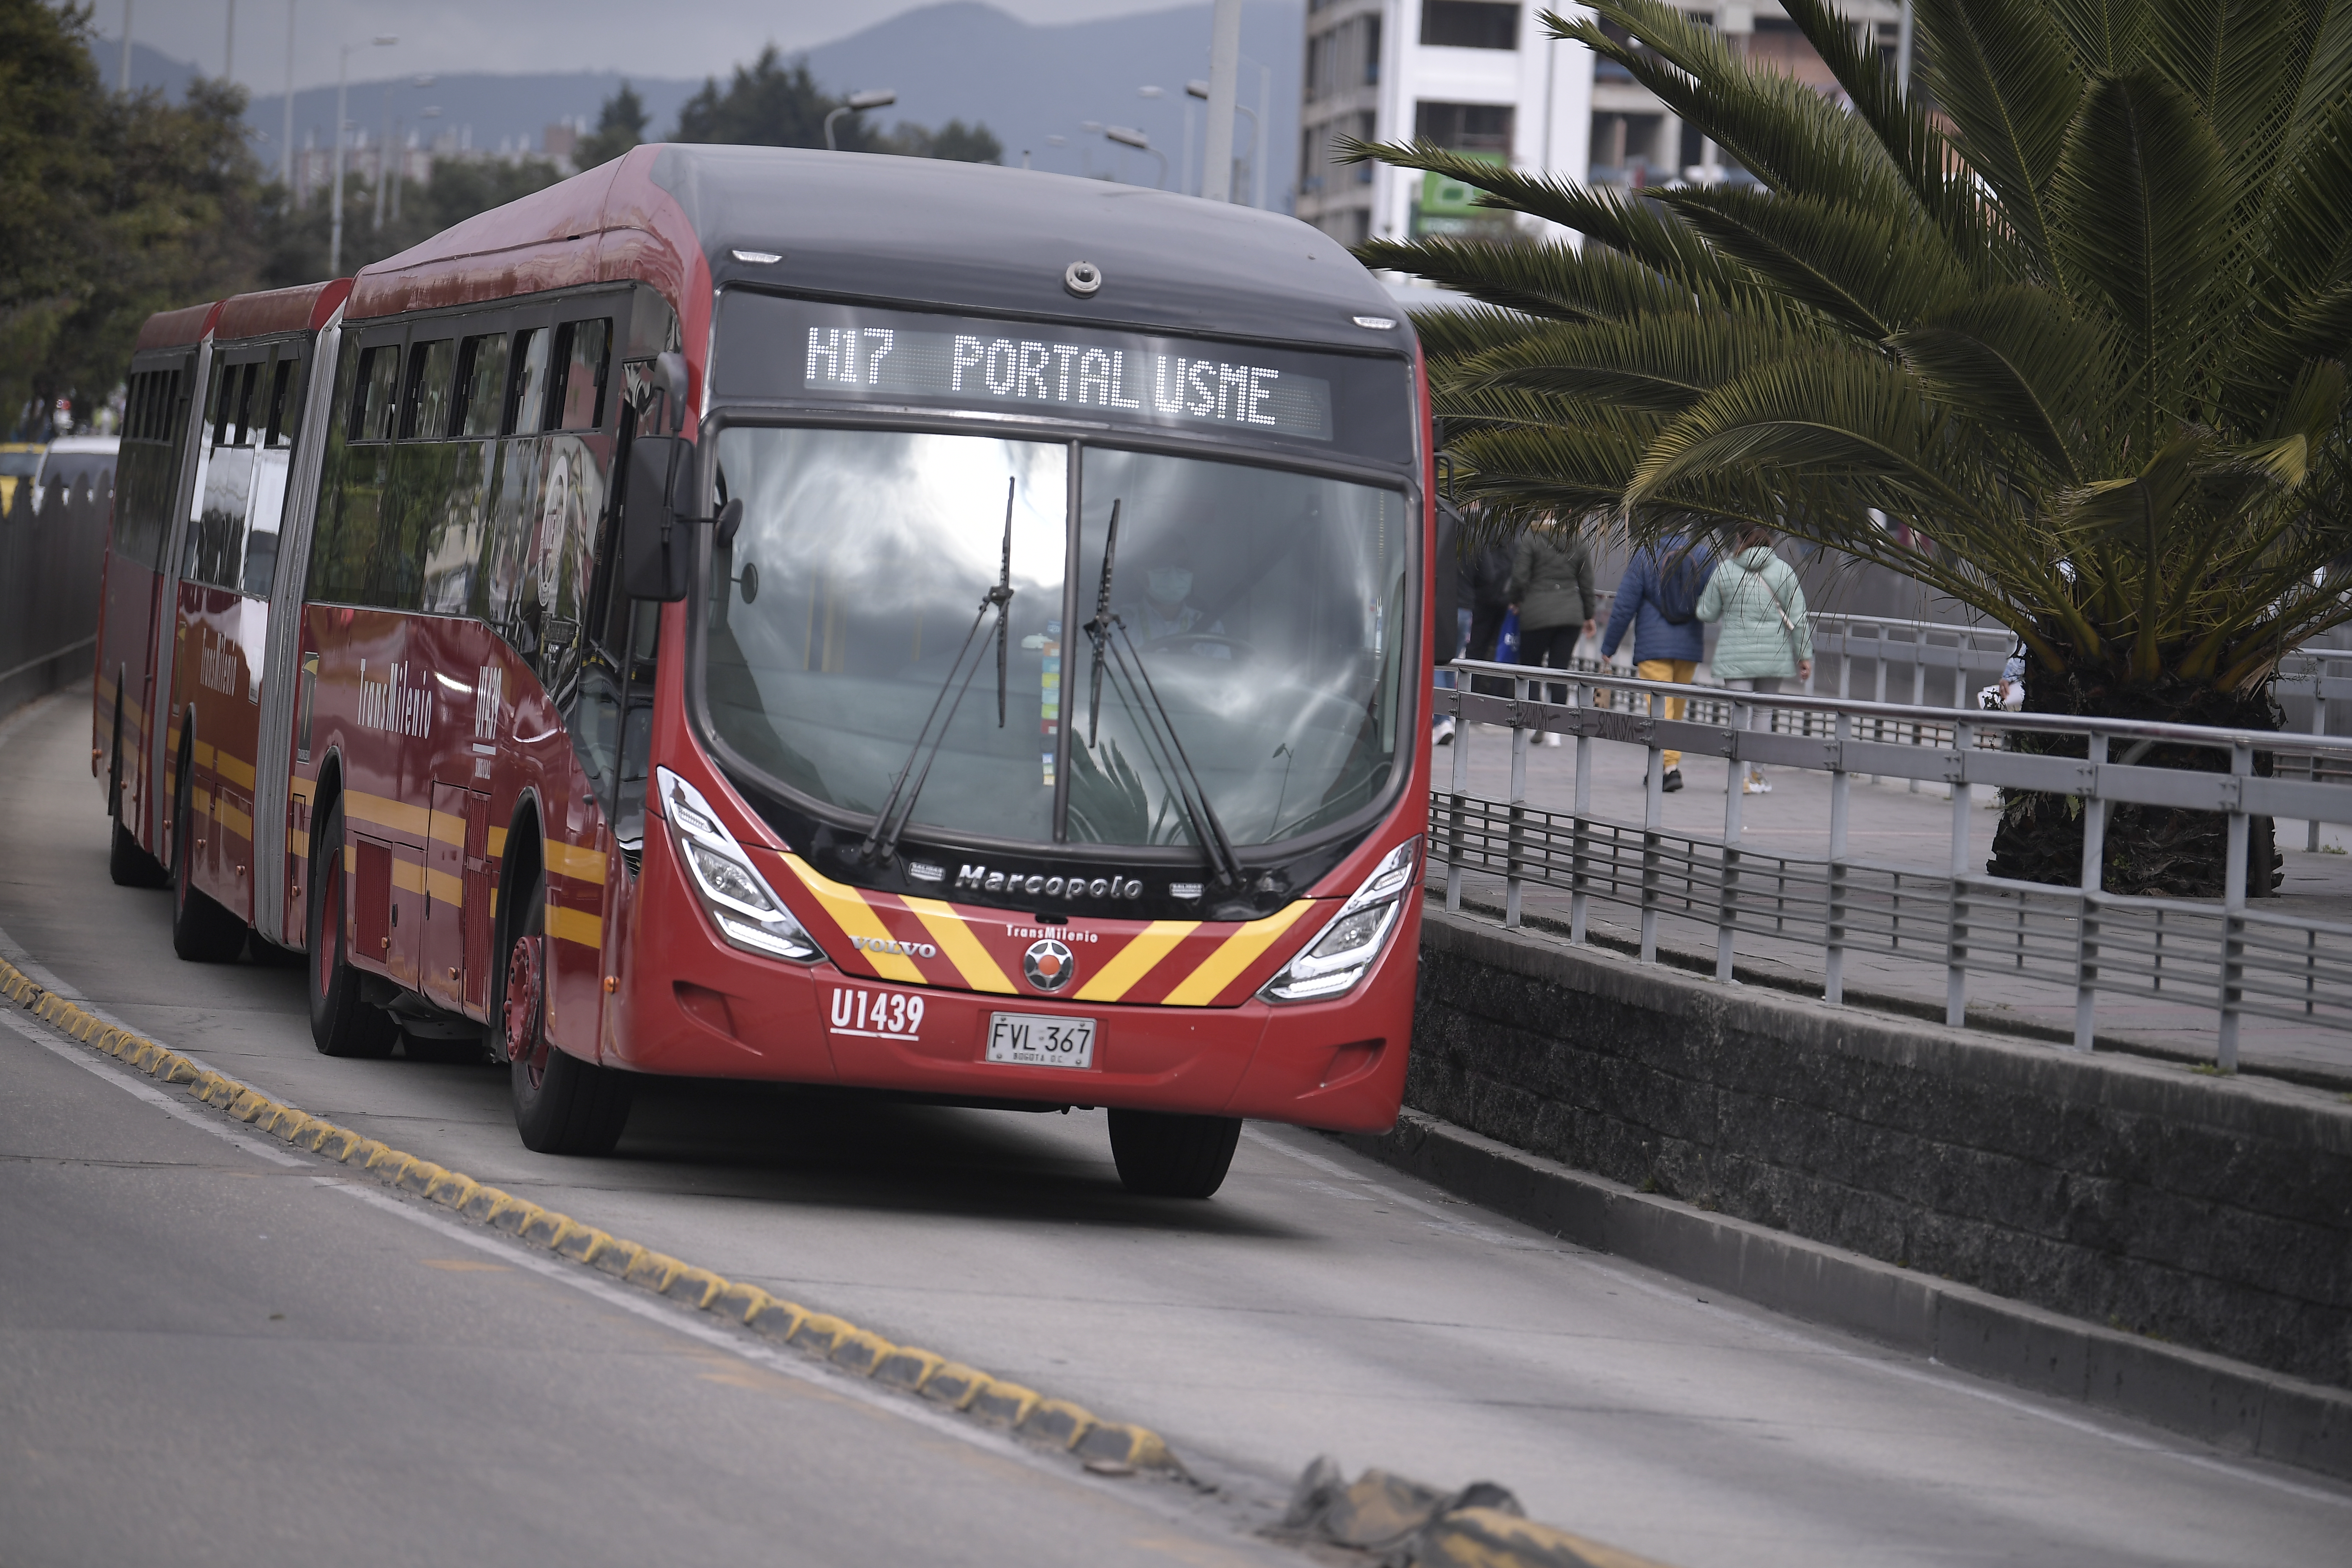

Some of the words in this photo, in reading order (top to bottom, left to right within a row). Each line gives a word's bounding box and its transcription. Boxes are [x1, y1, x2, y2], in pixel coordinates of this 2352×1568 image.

[806, 327, 894, 384] H17
[952, 334, 1140, 409] PORTAL
[1154, 355, 1279, 425] USME
[200, 628, 237, 696] TransMilenio
[357, 659, 431, 739] TransMilenio
[475, 666, 502, 739] U1439
[955, 865, 1143, 898] Marcopolo
[849, 935, 936, 958] VOLVO
[1007, 924, 1098, 943] TransMilenio
[831, 988, 925, 1034] U1439
